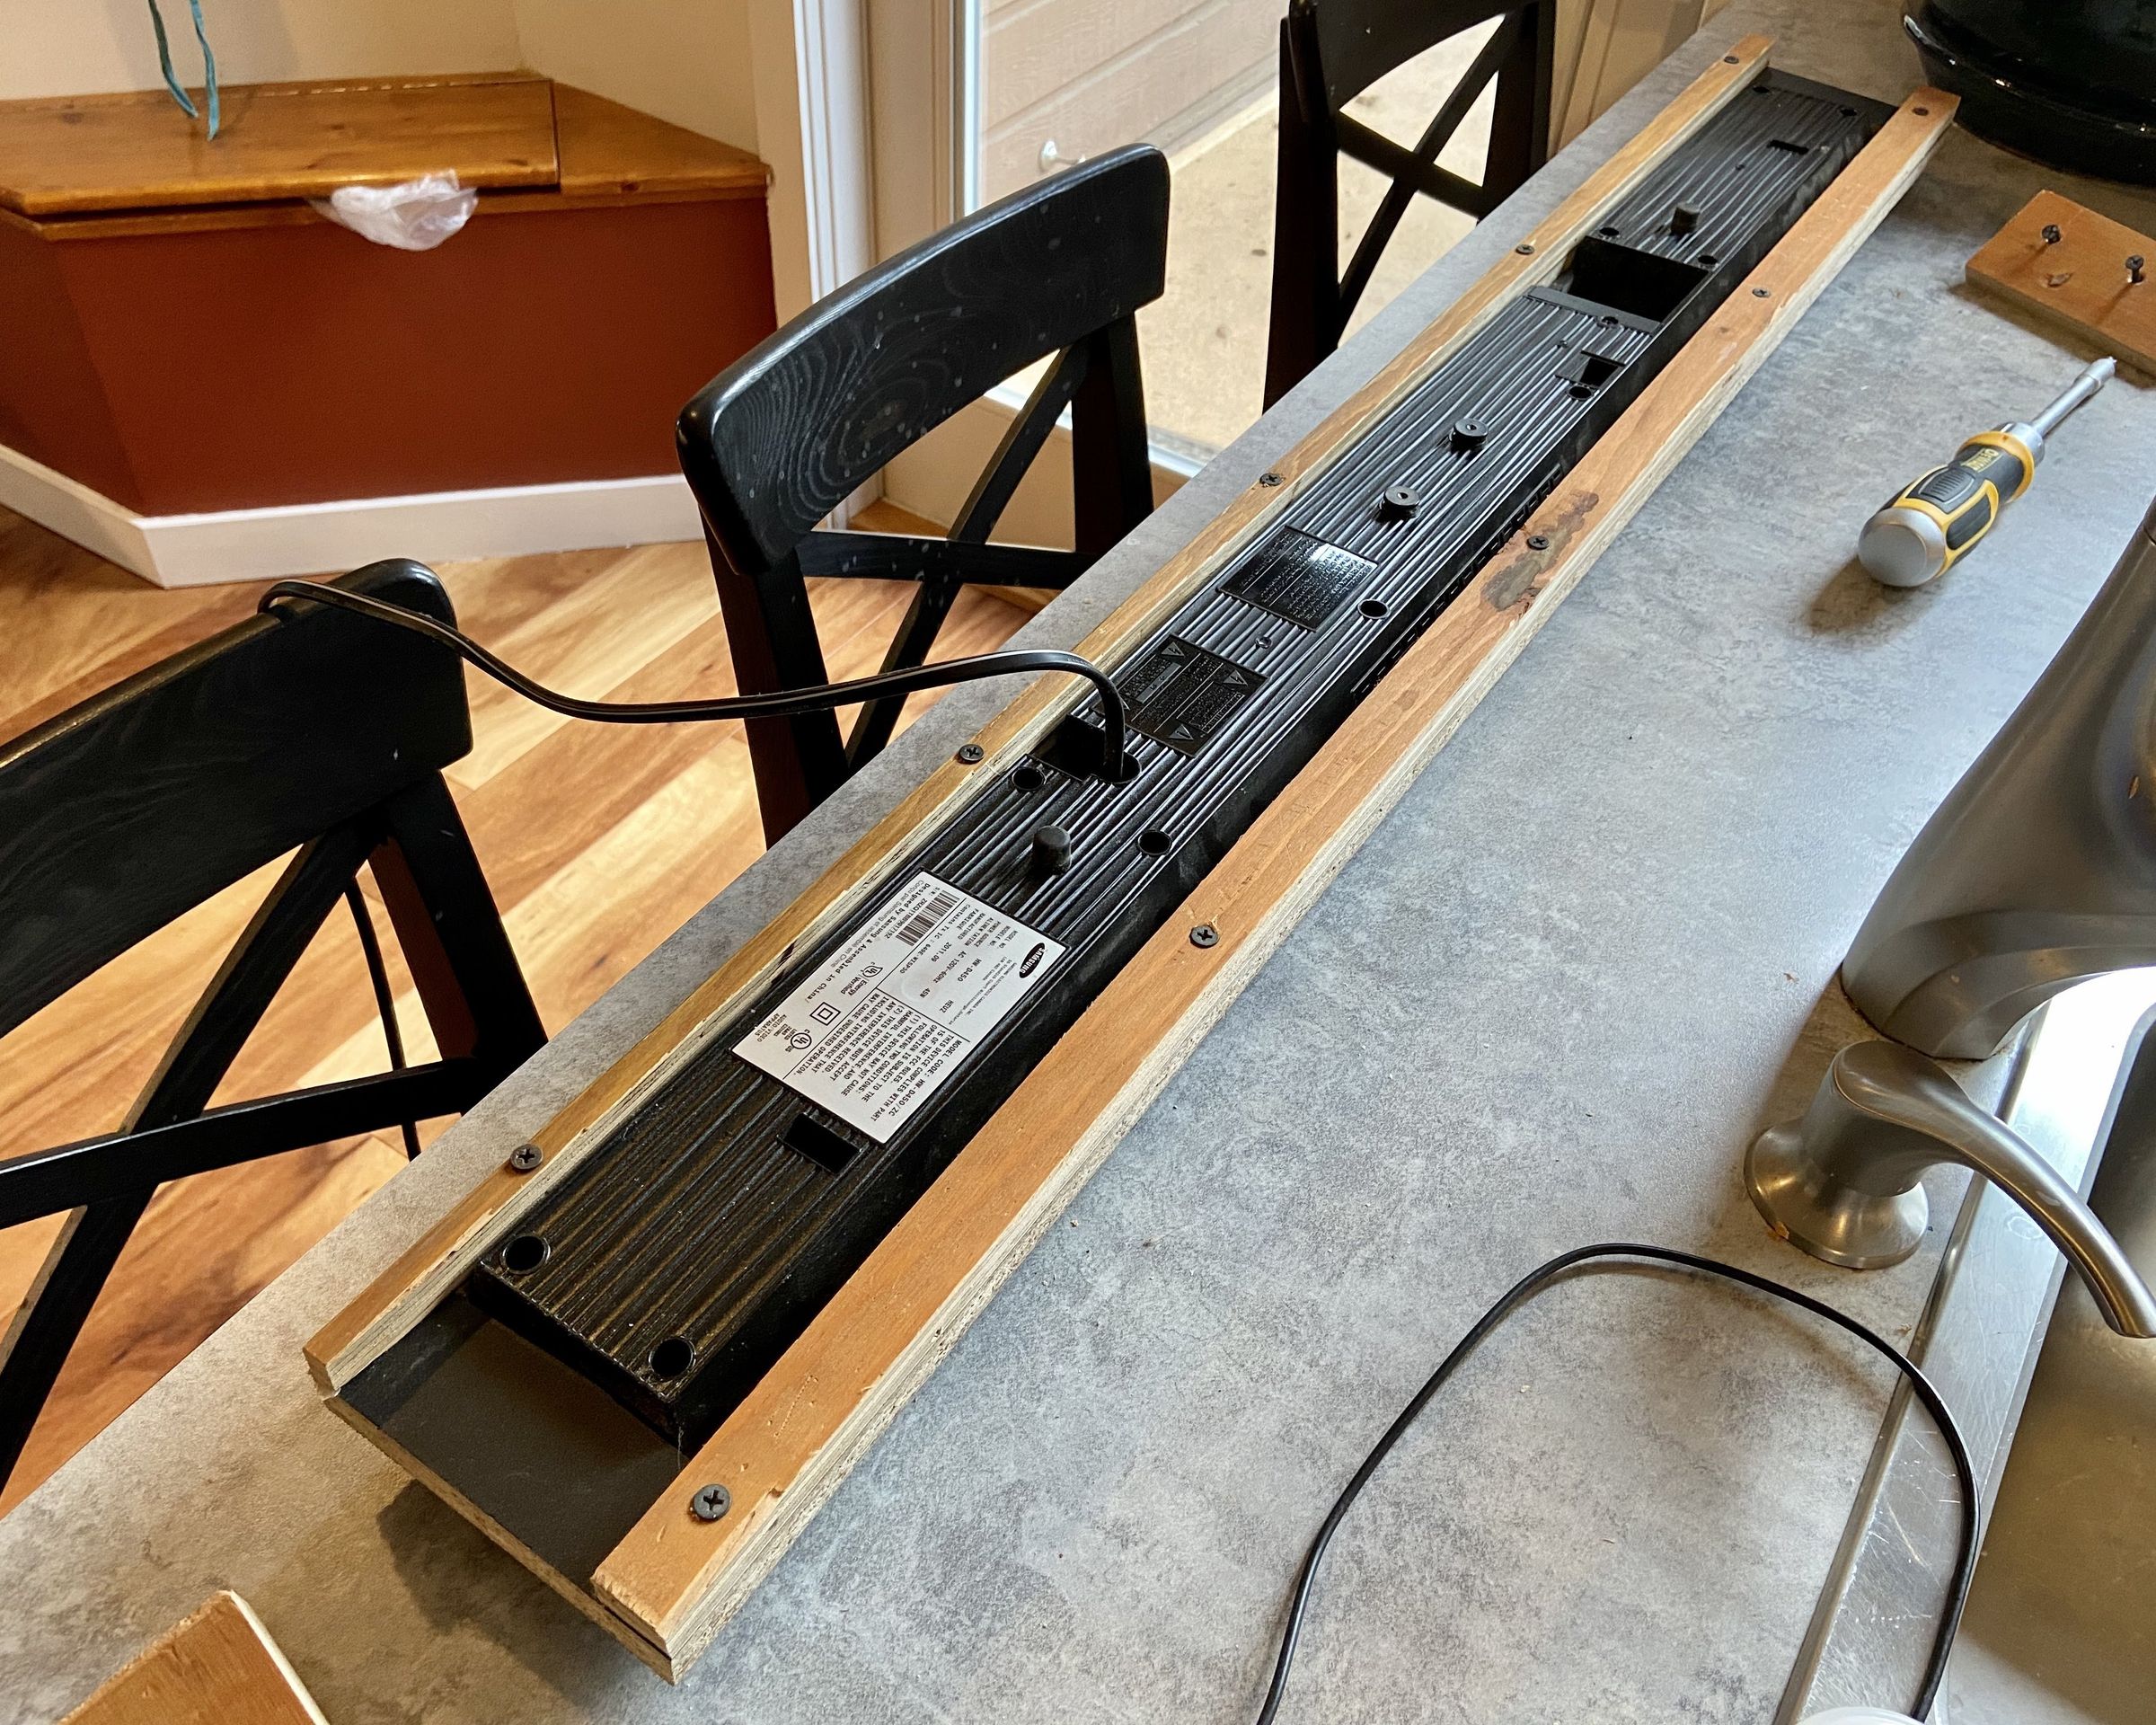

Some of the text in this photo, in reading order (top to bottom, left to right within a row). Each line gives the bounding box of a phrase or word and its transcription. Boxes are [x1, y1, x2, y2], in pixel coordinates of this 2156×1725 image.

[901, 881, 931, 907] Designed
[877, 899, 902, 922] Samsung
[947, 903, 972, 925] Contains
[869, 915, 897, 939] Samsung
[956, 912, 986, 940] MANUFACTURED
[972, 920, 1002, 947] POWER SOURCE
[834, 943, 868, 974] Assembled
[929, 941, 952, 962] 2011.09
[1017, 946, 1047, 974] SAMSUNG
[956, 957, 982, 982] HW-D450
[839, 975, 862, 995] Verified
[846, 978, 868, 996] Energy
[851, 1002, 870, 1020] CAUSE
[879, 1014, 896, 1029] THIS
[889, 1009, 914, 1032] HARMFUL
[753, 1012, 781, 1037] APPARATUS
[808, 995, 889, 1073] INCLUDING INTERFERENCE THAT
[823, 1018, 854, 1047] UNDESIRED
[848, 1011, 887, 1048] INTERFERENCE
[896, 1024, 913, 1039] THIS
[792, 1034, 808, 1047] UL
[861, 1027, 883, 1048] DEVICE
[877, 1037, 899, 1057] DEVICE
[897, 1022, 928, 1050] FOLLOWING
[908, 1023, 939, 1052] OPERATION
[847, 1047, 864, 1061] MUST
[907, 1054, 922, 1066] FCC
[918, 1043, 932, 1056] THE
[941, 1039, 963, 1059] MODEL
[827, 1060, 851, 1081] ACCEPT
[866, 1056, 881, 1069] MAY
[879, 1058, 905, 1083] SUBJECT
[869, 1033, 955, 1121] THIS DEVICE COMPLIES WITH PART
[889, 1065, 912, 1085] RULES.
[839, 1078, 859, 1097] CAUSE
[860, 1090, 874, 1102] THE
[886, 1077, 926, 1117] HW-D450/ZC
